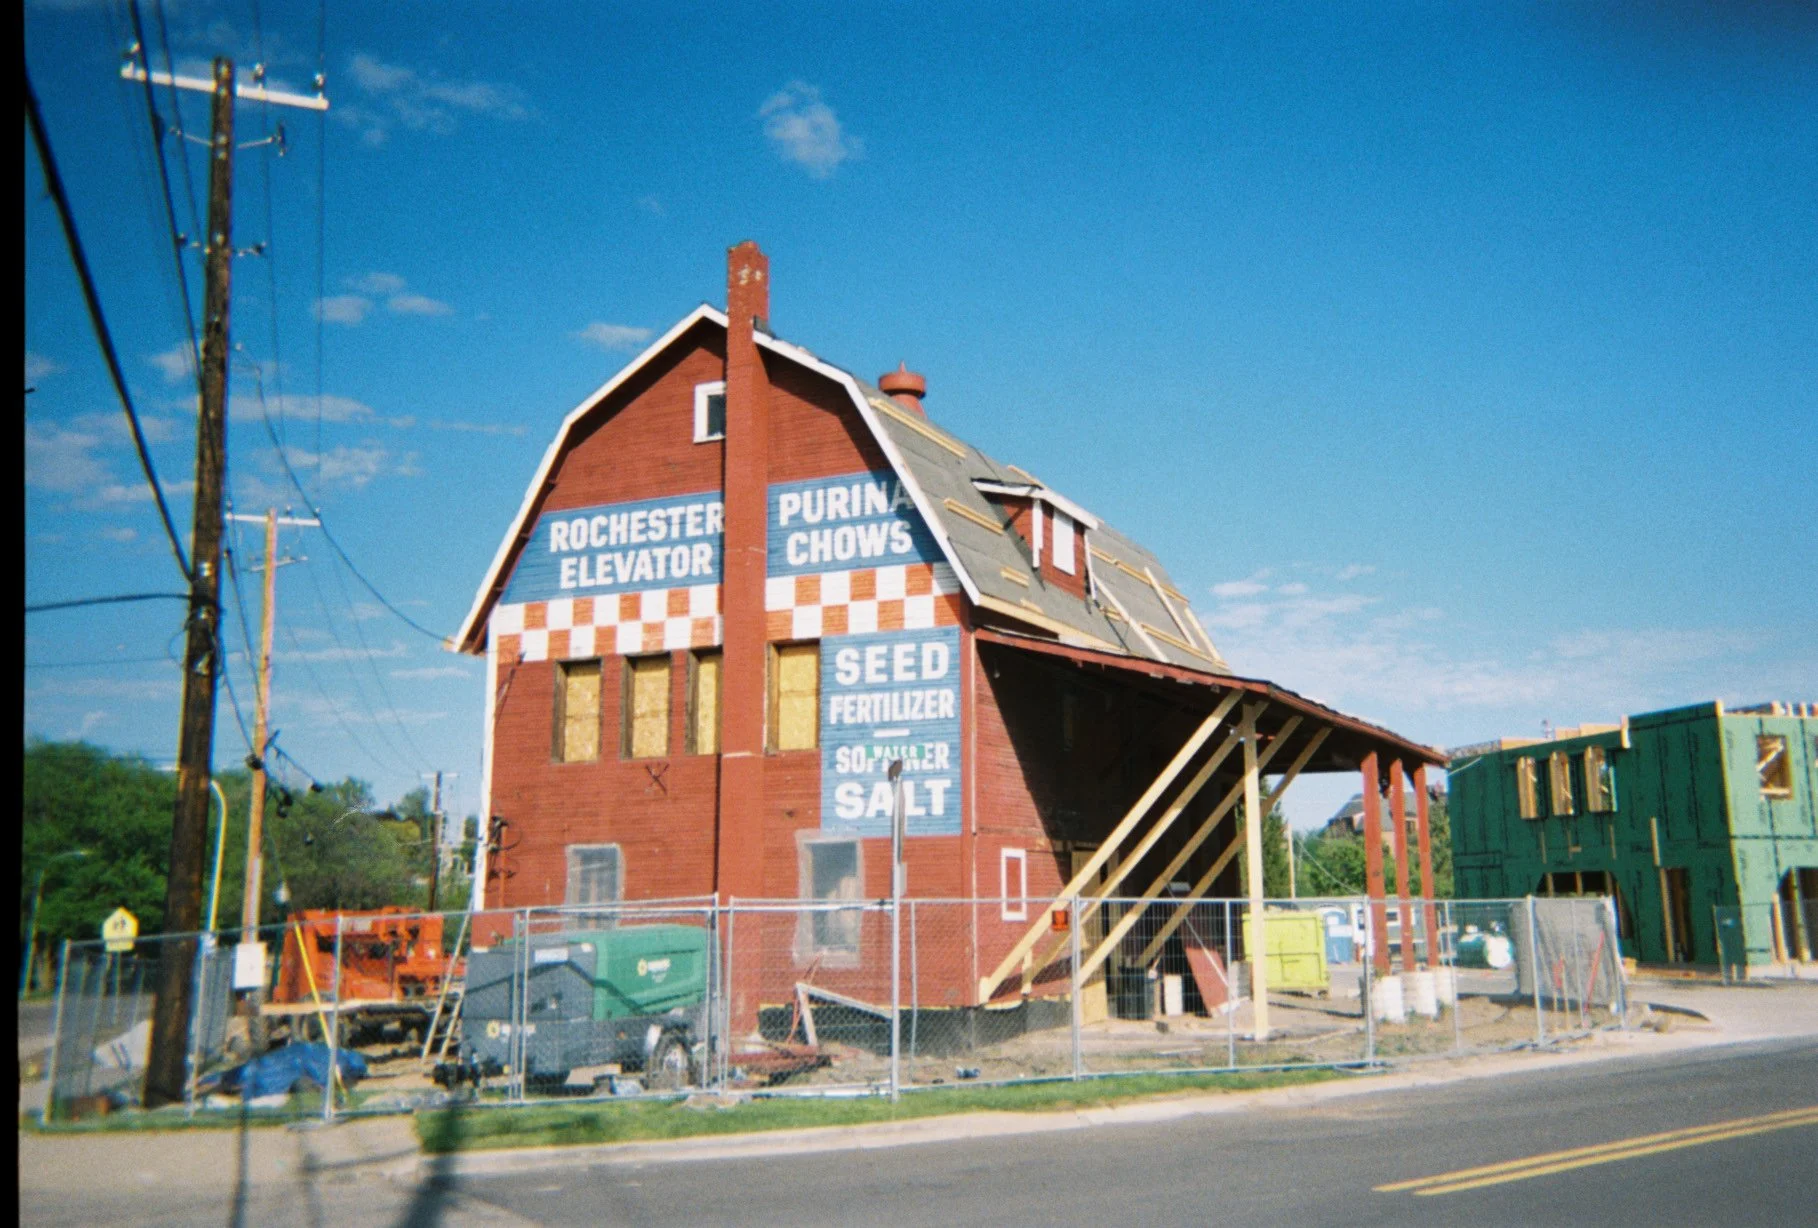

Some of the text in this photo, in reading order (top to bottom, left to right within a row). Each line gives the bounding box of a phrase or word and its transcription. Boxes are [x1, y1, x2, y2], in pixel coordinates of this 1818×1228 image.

[779, 480, 916, 526] PURINA
[550, 501, 724, 552] ROCHESTER
[787, 520, 913, 566] CHOWS
[560, 542, 713, 589] ELEVATOR
[835, 641, 949, 686] SEED
[830, 688, 955, 725] FERTILIZER
[834, 779, 952, 820] SALT
